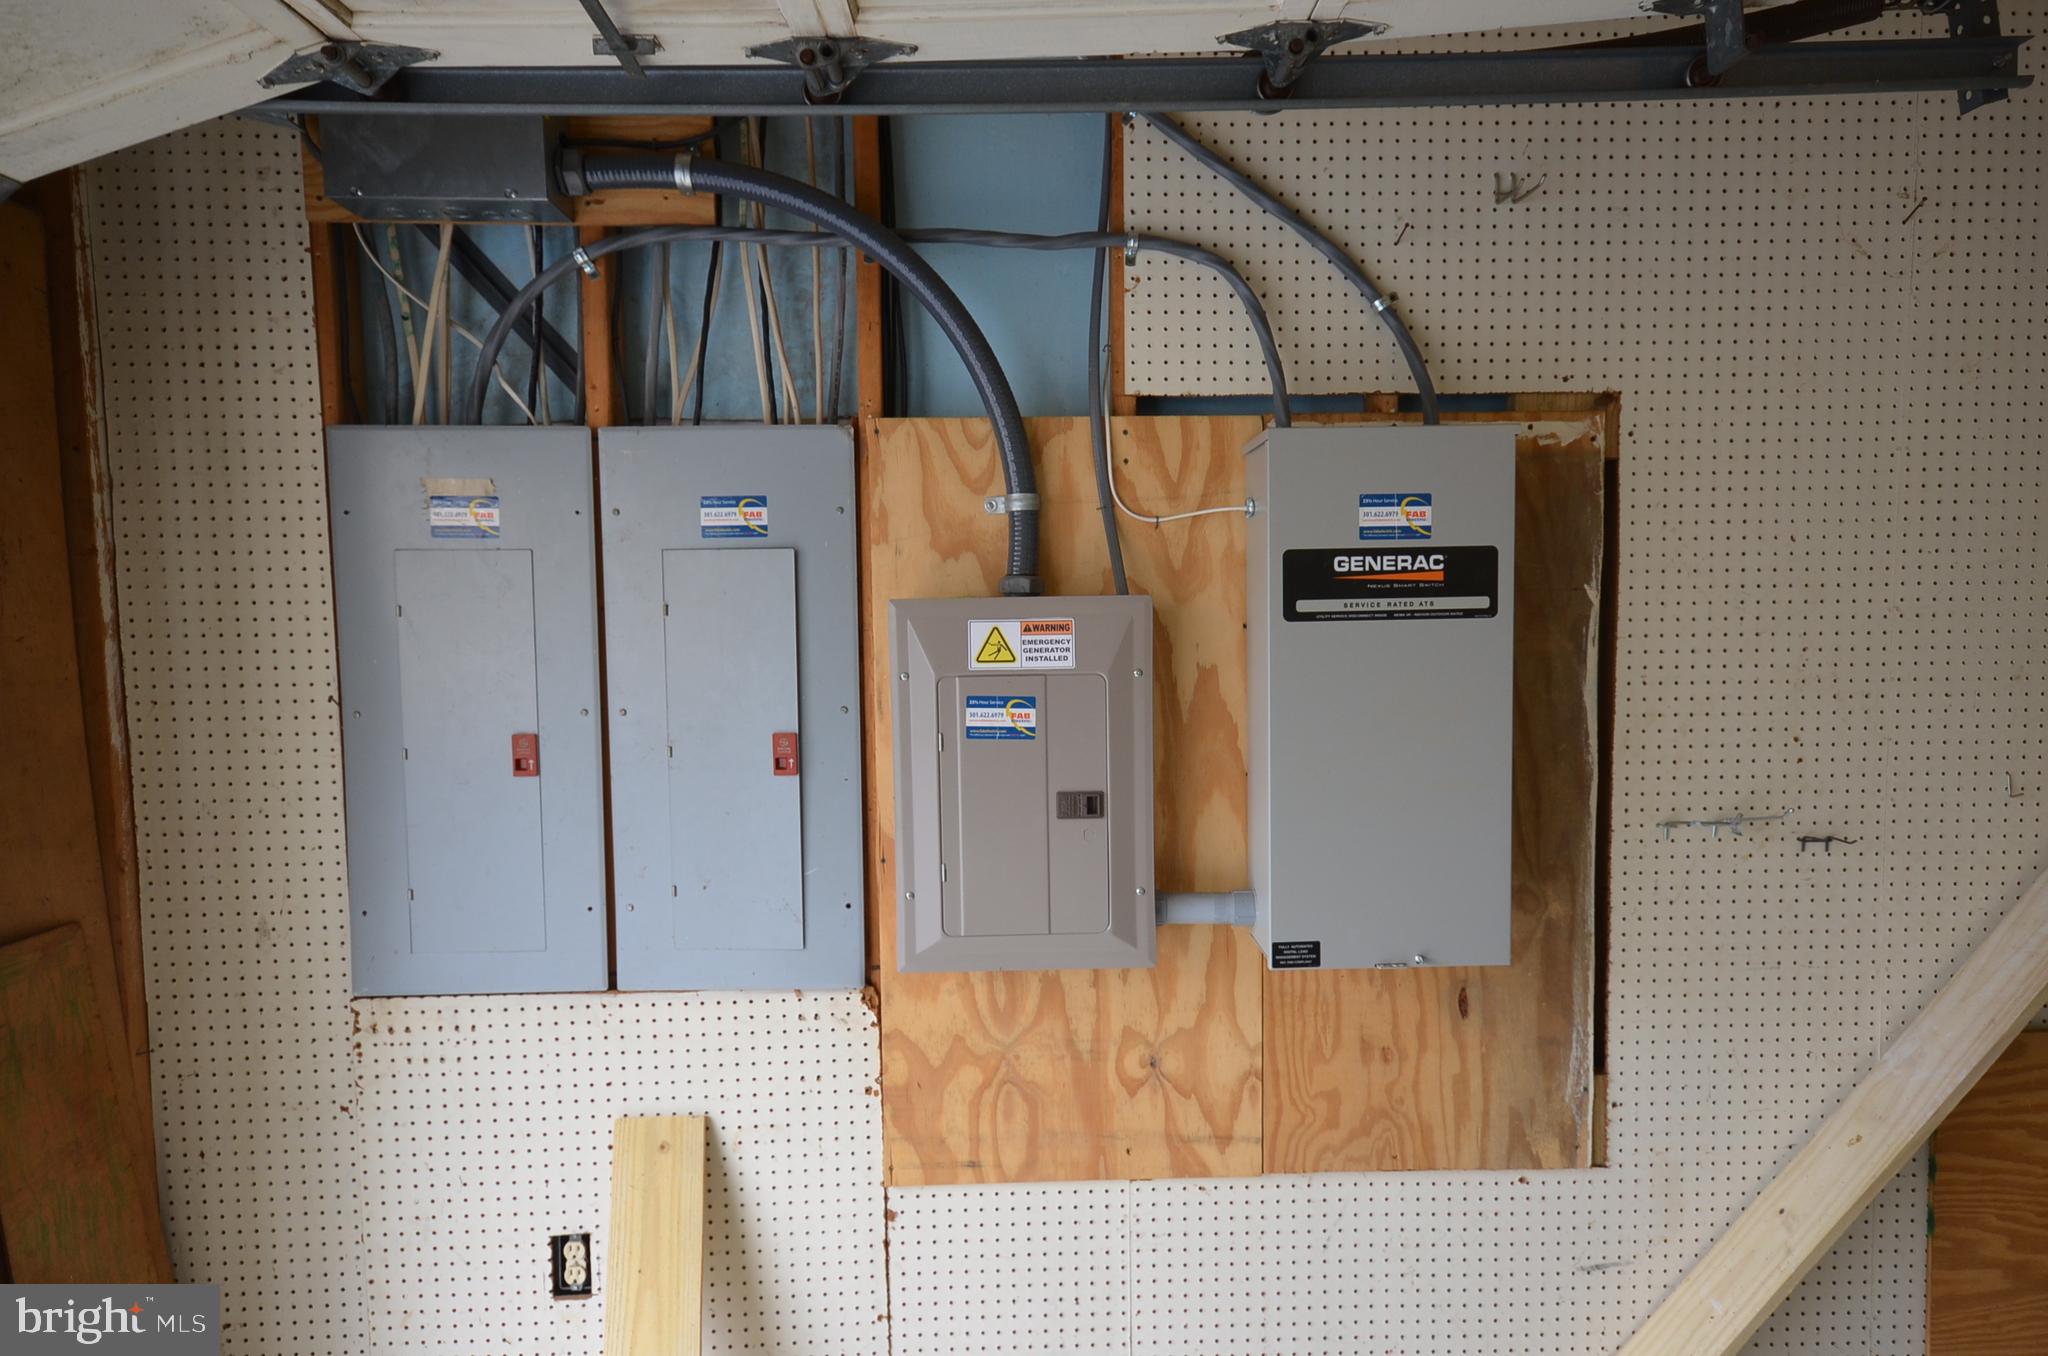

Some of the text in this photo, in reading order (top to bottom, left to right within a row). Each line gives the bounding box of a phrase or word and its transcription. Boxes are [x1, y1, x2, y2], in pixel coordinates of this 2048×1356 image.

[1333, 554, 1445, 572] GENERAC
[1343, 601, 1381, 609] SERVICE
[1419, 600, 1435, 608] ATS
[1032, 623, 1071, 632] WARNING
[1022, 638, 1072, 646] EMERGENCY
[1023, 646, 1071, 654] GENERATOR
